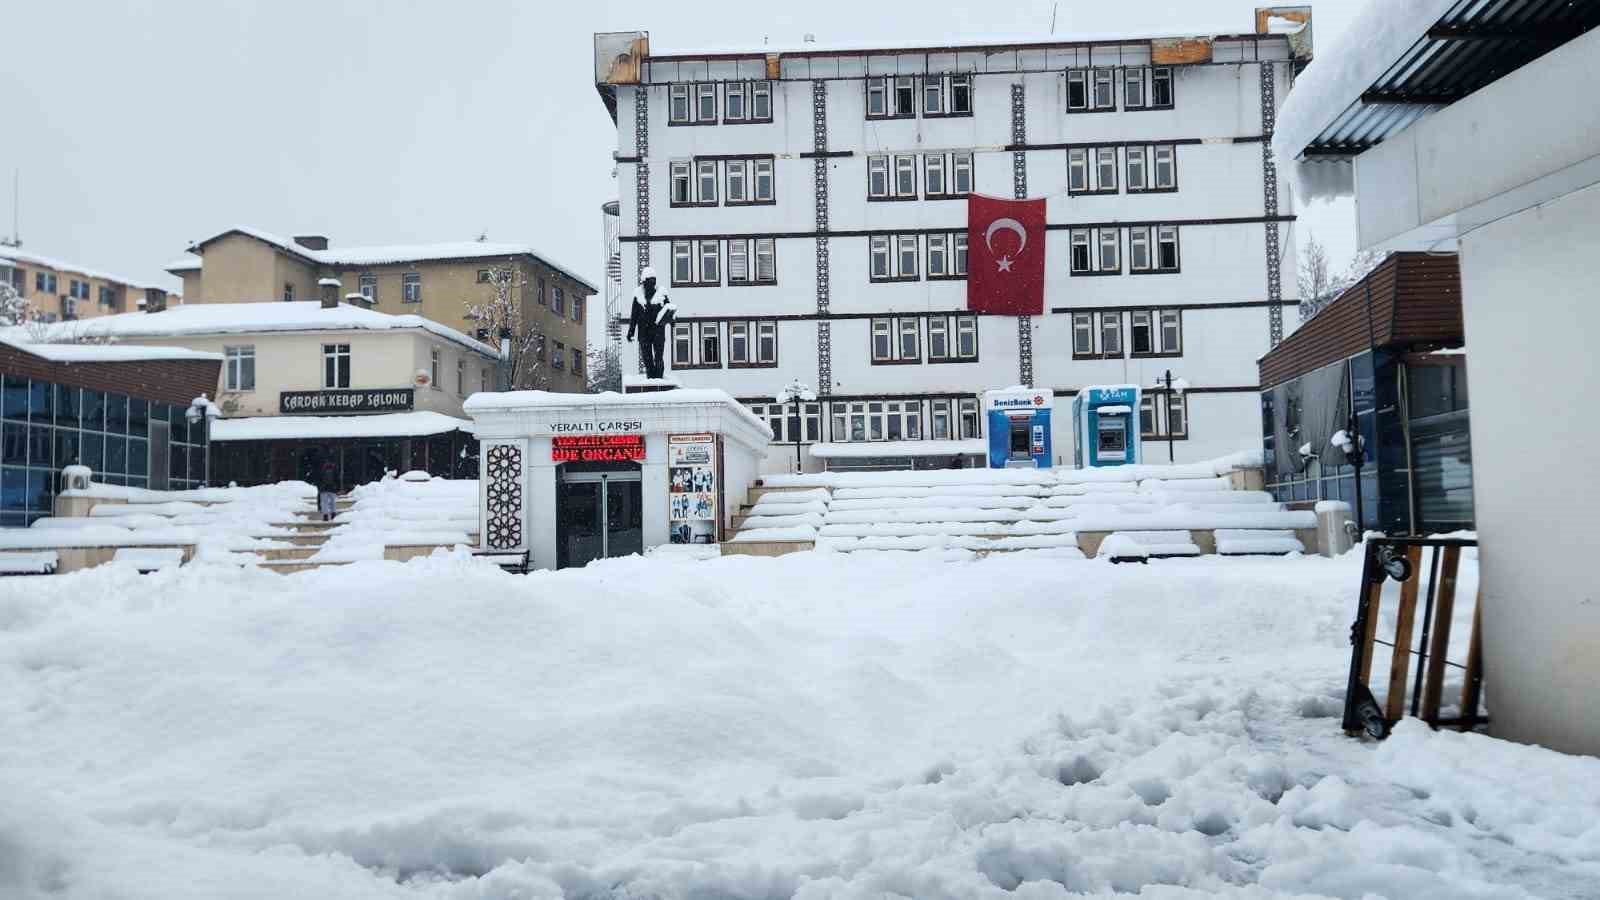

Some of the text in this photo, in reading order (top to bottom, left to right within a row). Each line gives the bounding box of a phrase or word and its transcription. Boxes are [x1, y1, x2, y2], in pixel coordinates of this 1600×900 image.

[328, 394, 364, 408] KEBAP
[367, 393, 407, 407] SALONU
[994, 399, 1032, 407] DenizBank
[550, 421, 642, 432] YERALTI ÇARŞISI
